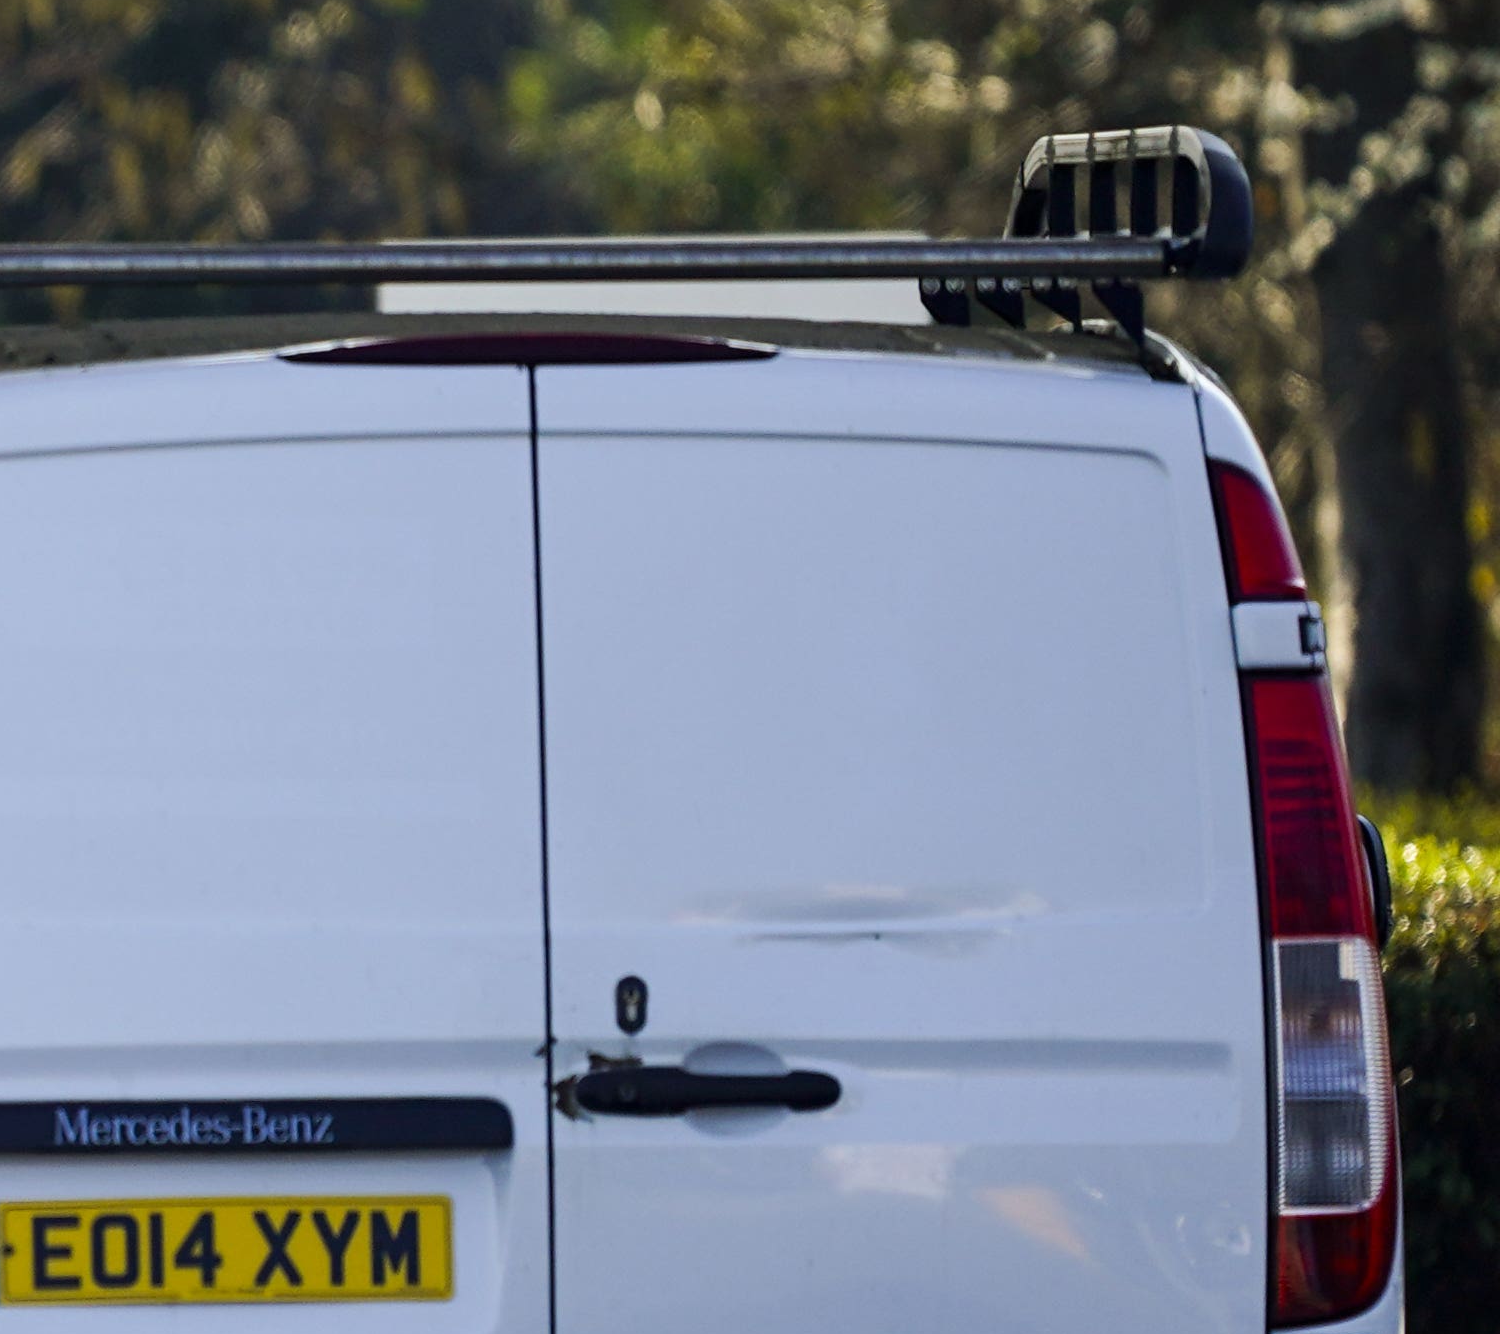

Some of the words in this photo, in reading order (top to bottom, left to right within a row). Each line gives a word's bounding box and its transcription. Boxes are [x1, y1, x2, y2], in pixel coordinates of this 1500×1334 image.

[53, 1105, 336, 1147] Mercedes-Benz
[32, 1210, 224, 1291] EO14
[252, 1208, 422, 1287] XYM
